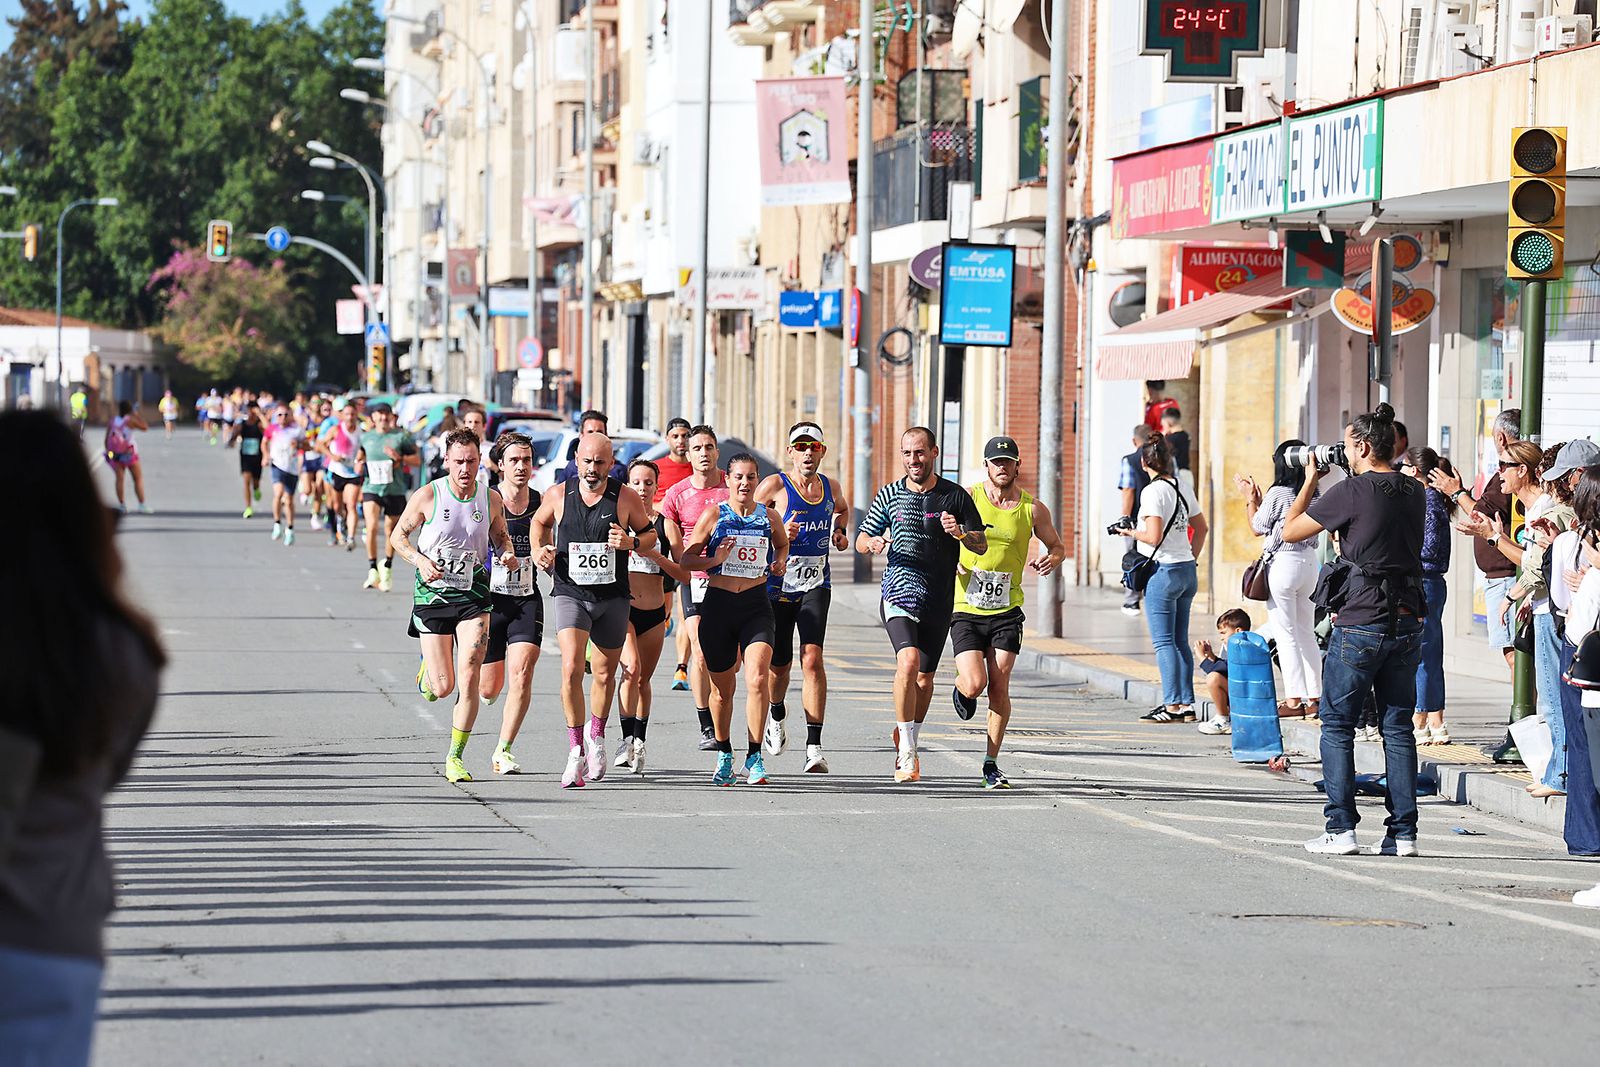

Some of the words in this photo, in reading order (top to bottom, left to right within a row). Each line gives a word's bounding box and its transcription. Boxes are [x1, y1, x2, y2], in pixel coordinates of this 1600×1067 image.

[1224, 131, 1285, 213] FARMACIA
[1290, 128, 1306, 204] EL
[1312, 113, 1362, 200] PUNTO
[949, 265, 1006, 279] EMTUSA
[1220, 270, 1242, 284] 24
[798, 519, 829, 533] FIAAL
[578, 554, 609, 569] 266
[737, 547, 757, 562] 63
[436, 558, 466, 575] 212
[506, 568, 521, 582] 11
[978, 581, 1004, 597] 196
